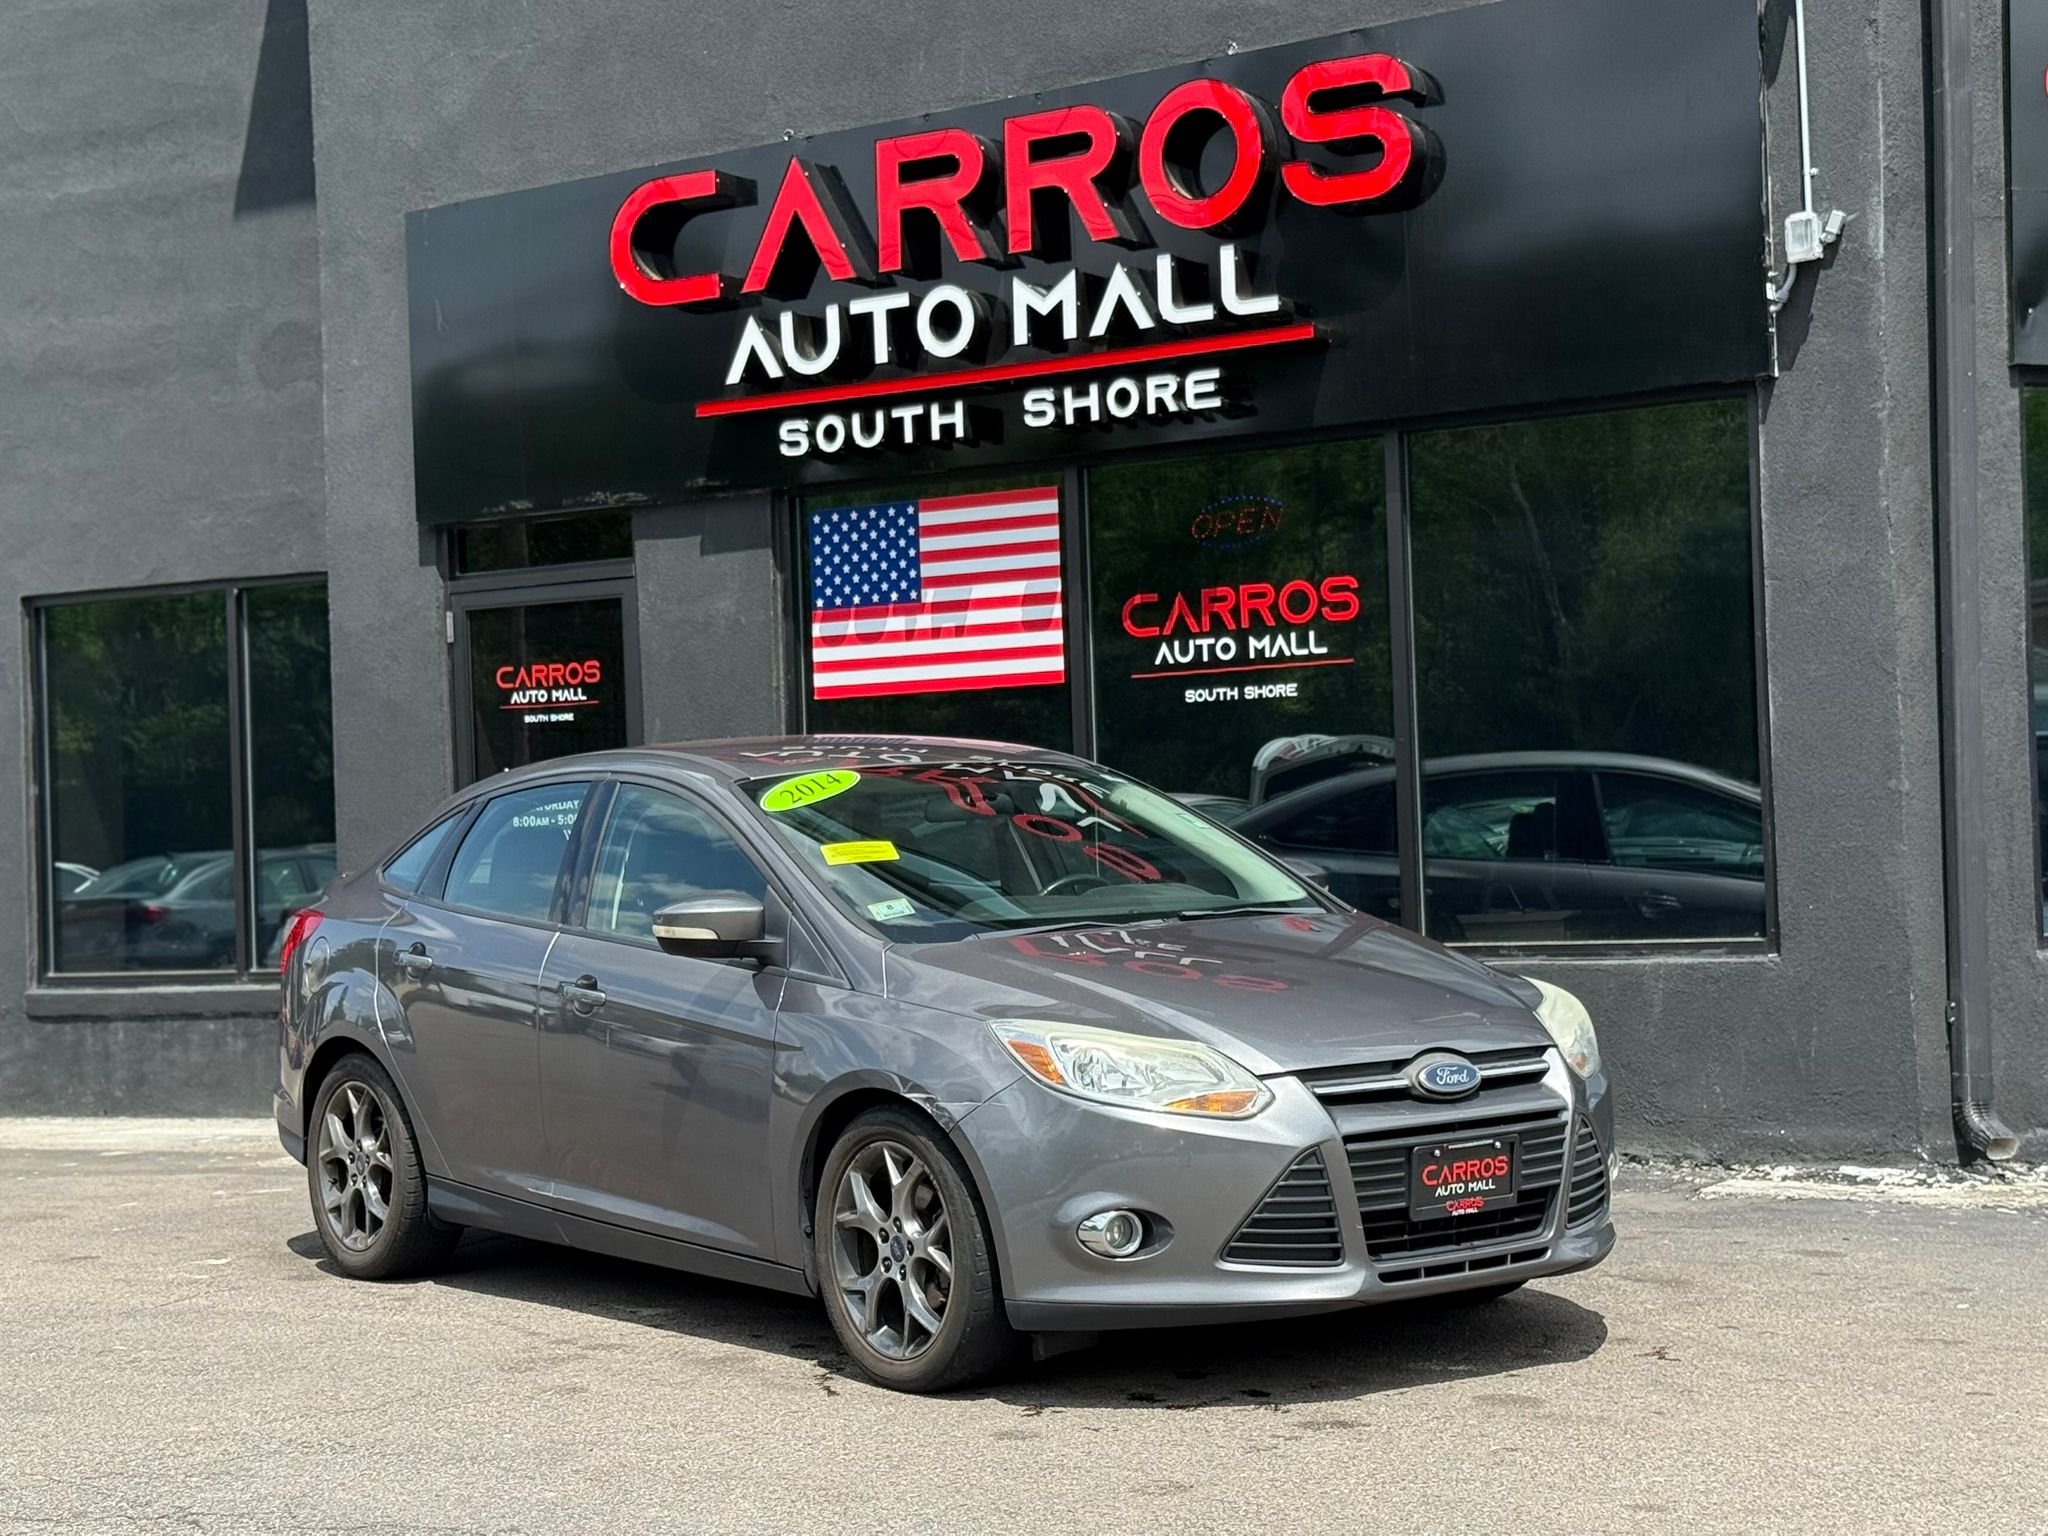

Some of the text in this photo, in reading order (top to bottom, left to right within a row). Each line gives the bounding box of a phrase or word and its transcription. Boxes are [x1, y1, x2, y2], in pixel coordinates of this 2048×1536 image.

[610, 52, 1411, 306] CARROS
[725, 244, 1282, 385] AUTO MALL
[779, 368, 1222, 457] SOUTH SHORE
[1191, 505, 1284, 538] OPEN
[1122, 575, 1360, 638] CARROS
[1154, 630, 1328, 666] AUTO MALL
[496, 660, 600, 689] CARROS
[510, 687, 588, 705] AUTO MALL
[1184, 682, 1298, 704] SOUTH SHORE
[524, 714, 549, 724] SOUTH
[780, 773, 842, 804] 2014
[512, 815, 550, 828] 8:00AM
[1436, 1066, 1470, 1085] Ford
[1422, 1155, 1509, 1186] CARROS
[1434, 1178, 1497, 1198] AUTO MALL
[1445, 1196, 1485, 1211] CARROS
